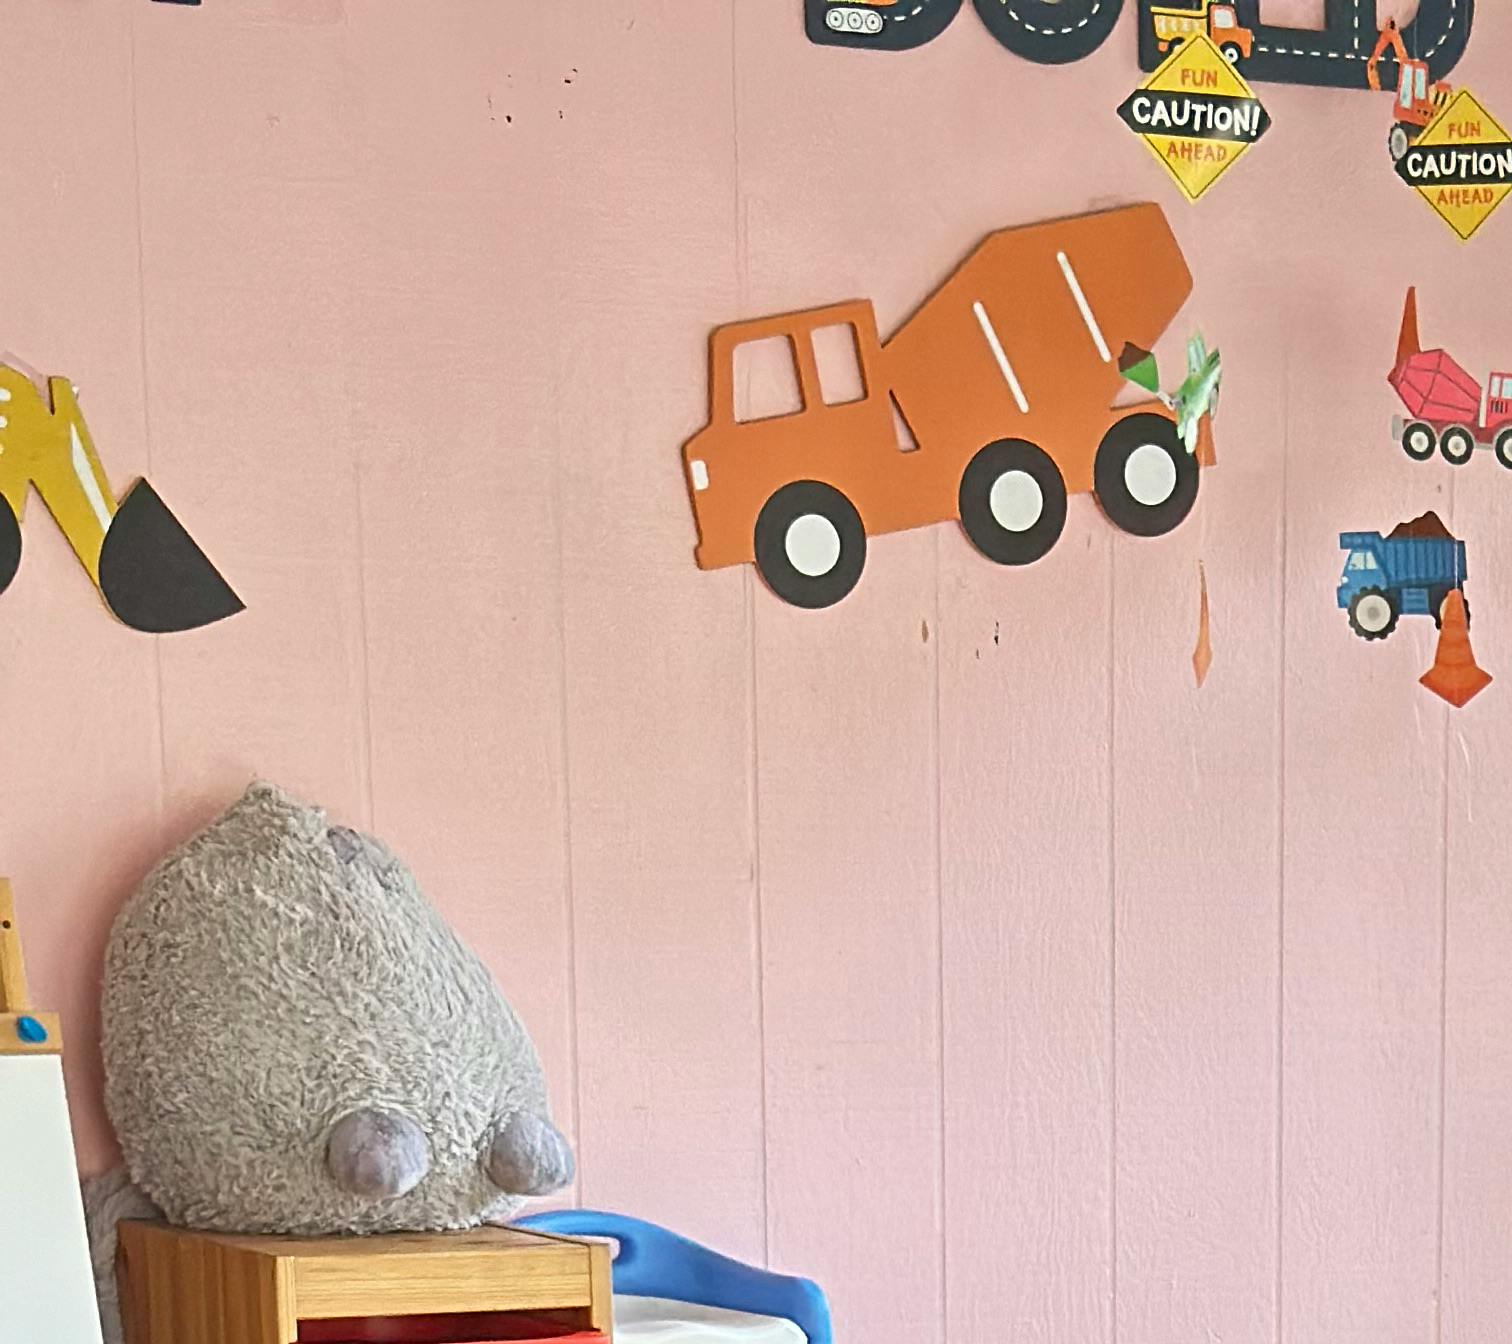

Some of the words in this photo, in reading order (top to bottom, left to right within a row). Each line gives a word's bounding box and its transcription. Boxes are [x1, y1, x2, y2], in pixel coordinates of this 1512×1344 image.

[1180, 68, 1218, 88] FUN
[1132, 96, 1261, 136] CAUTION!
[1447, 121, 1481, 139] FUN
[1165, 140, 1228, 162] AHEAD
[1436, 187, 1494, 208] AHEAD
